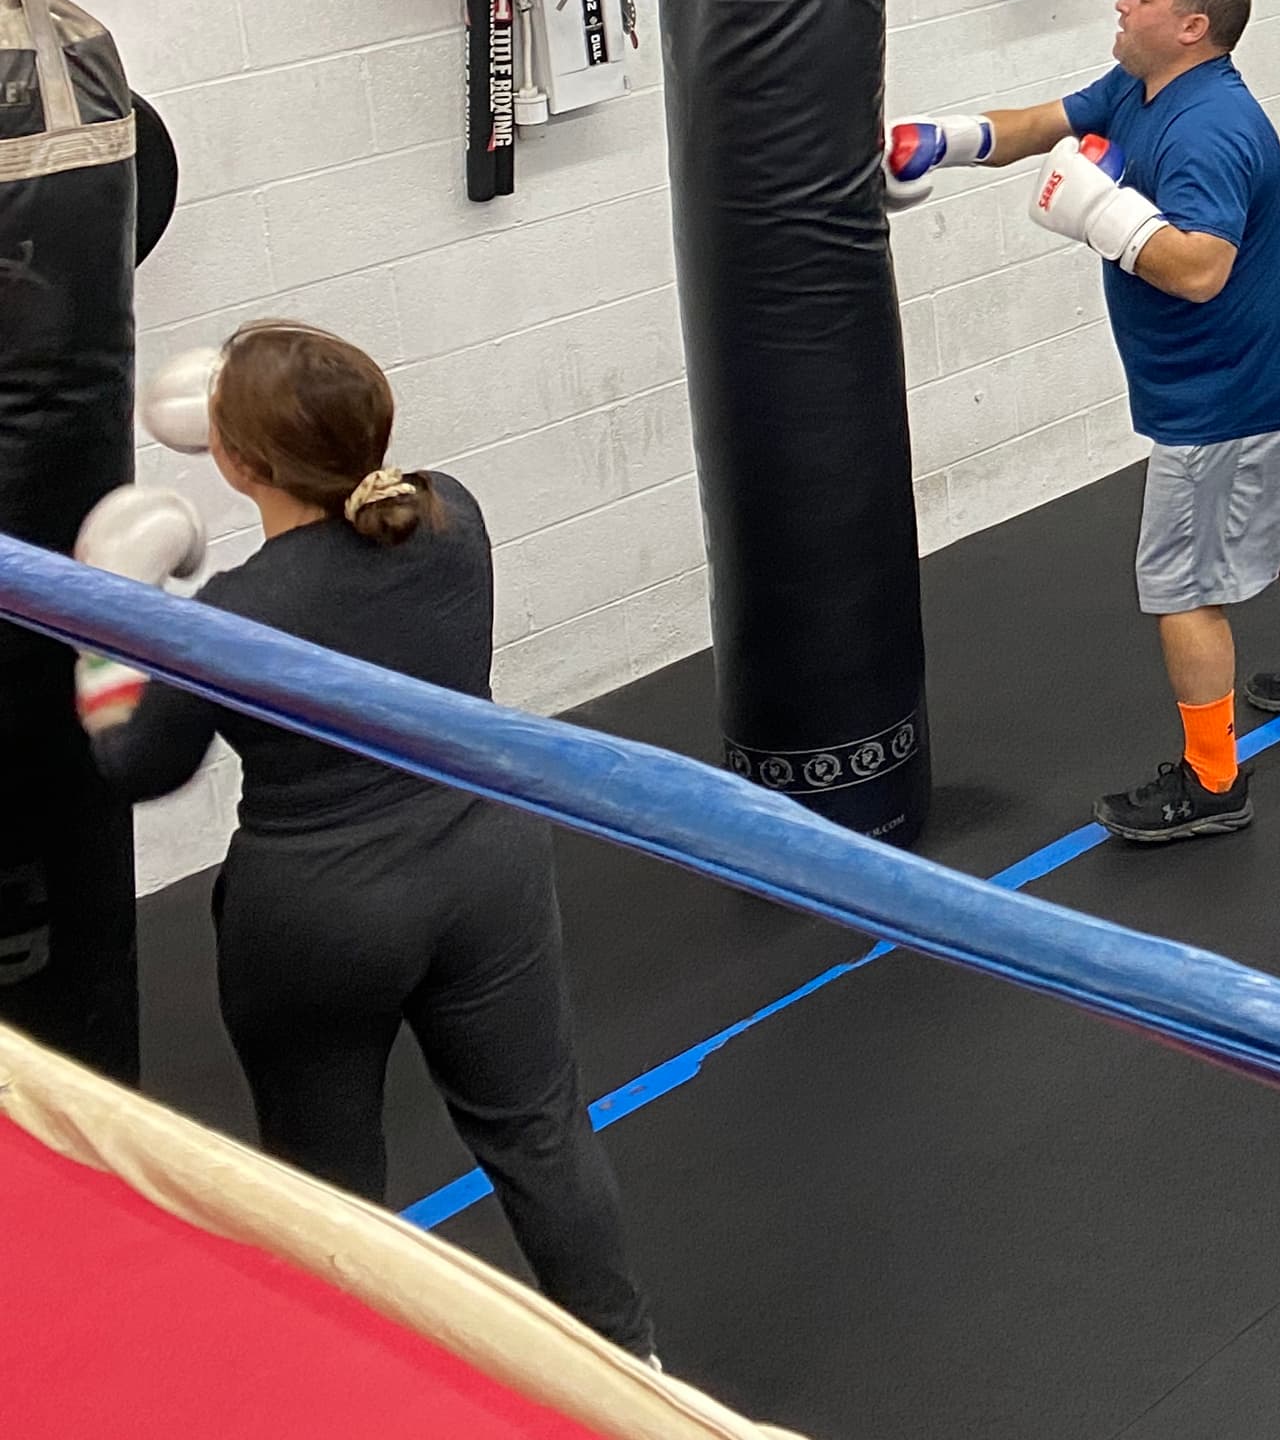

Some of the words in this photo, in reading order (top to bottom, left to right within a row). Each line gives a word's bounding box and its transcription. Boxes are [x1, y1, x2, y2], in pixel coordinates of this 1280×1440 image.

[494, 26, 512, 76] TITLE
[590, 33, 603, 61] OFF
[493, 78, 513, 148] BOXING
